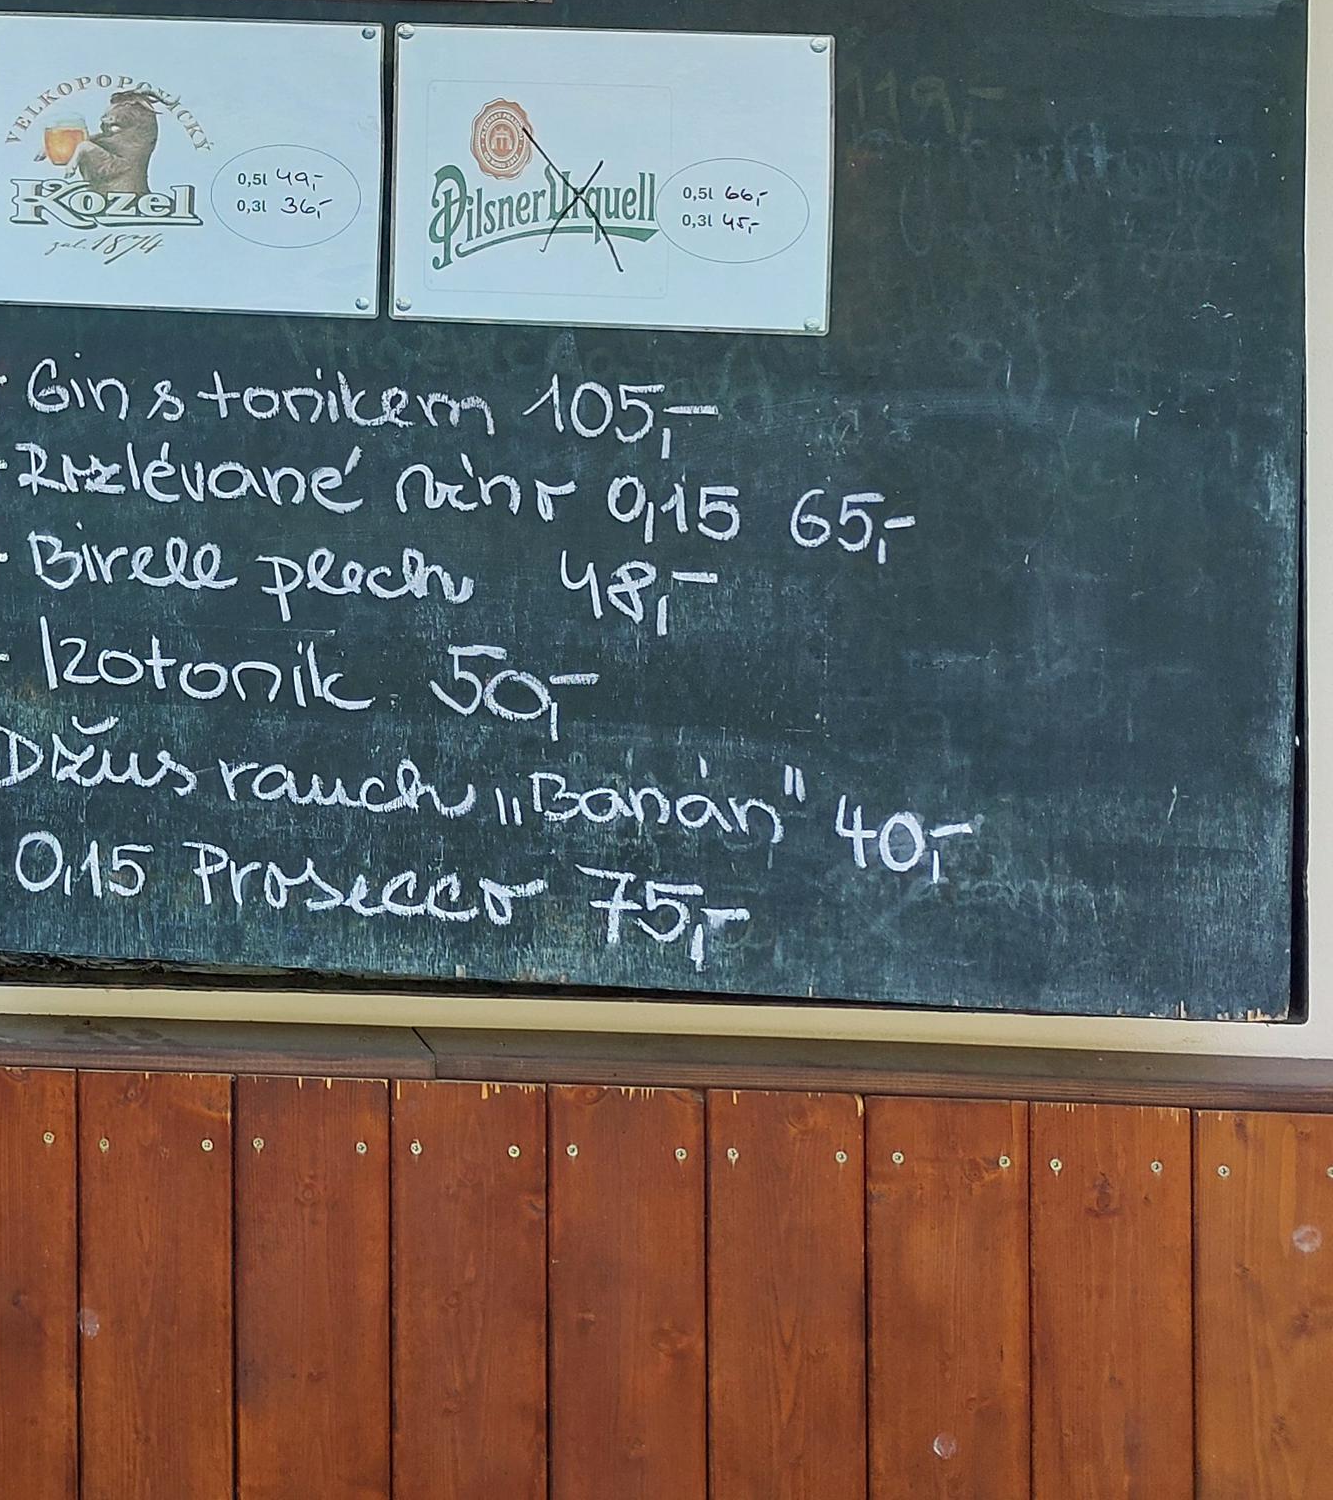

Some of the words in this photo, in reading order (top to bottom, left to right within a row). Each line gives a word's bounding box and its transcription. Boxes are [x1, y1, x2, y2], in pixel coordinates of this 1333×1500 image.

[4, 74, 213, 153] VELKOPOPOVICKÝ
[10, 178, 203, 228] Kozel
[237, 171, 267, 187] 0,5l
[237, 198, 267, 213] 0,3l
[280, 195, 333, 220] 36,-
[428, 164, 545, 271] Pilsner
[545, 165, 656, 243] Urquell
[683, 186, 714, 201] 0,5l
[682, 214, 713, 228] 0,3l
[27, 358, 129, 421] Gin
[148, 384, 185, 421] s
[197, 370, 495, 437] tonikem
[522, 373, 719, 459] 105,-
[788, 488, 916, 565] 65,-
[256, 549, 476, 623] plech
[559, 549, 718, 636] 48,-
[39, 615, 376, 712] Izotonik
[429, 643, 599, 742] 50,-
[221, 757, 476, 816] rauch
[836, 793, 974, 884] 40,-
[183, 841, 548, 926] Prosecco
[575, 863, 750, 971] 75,-
